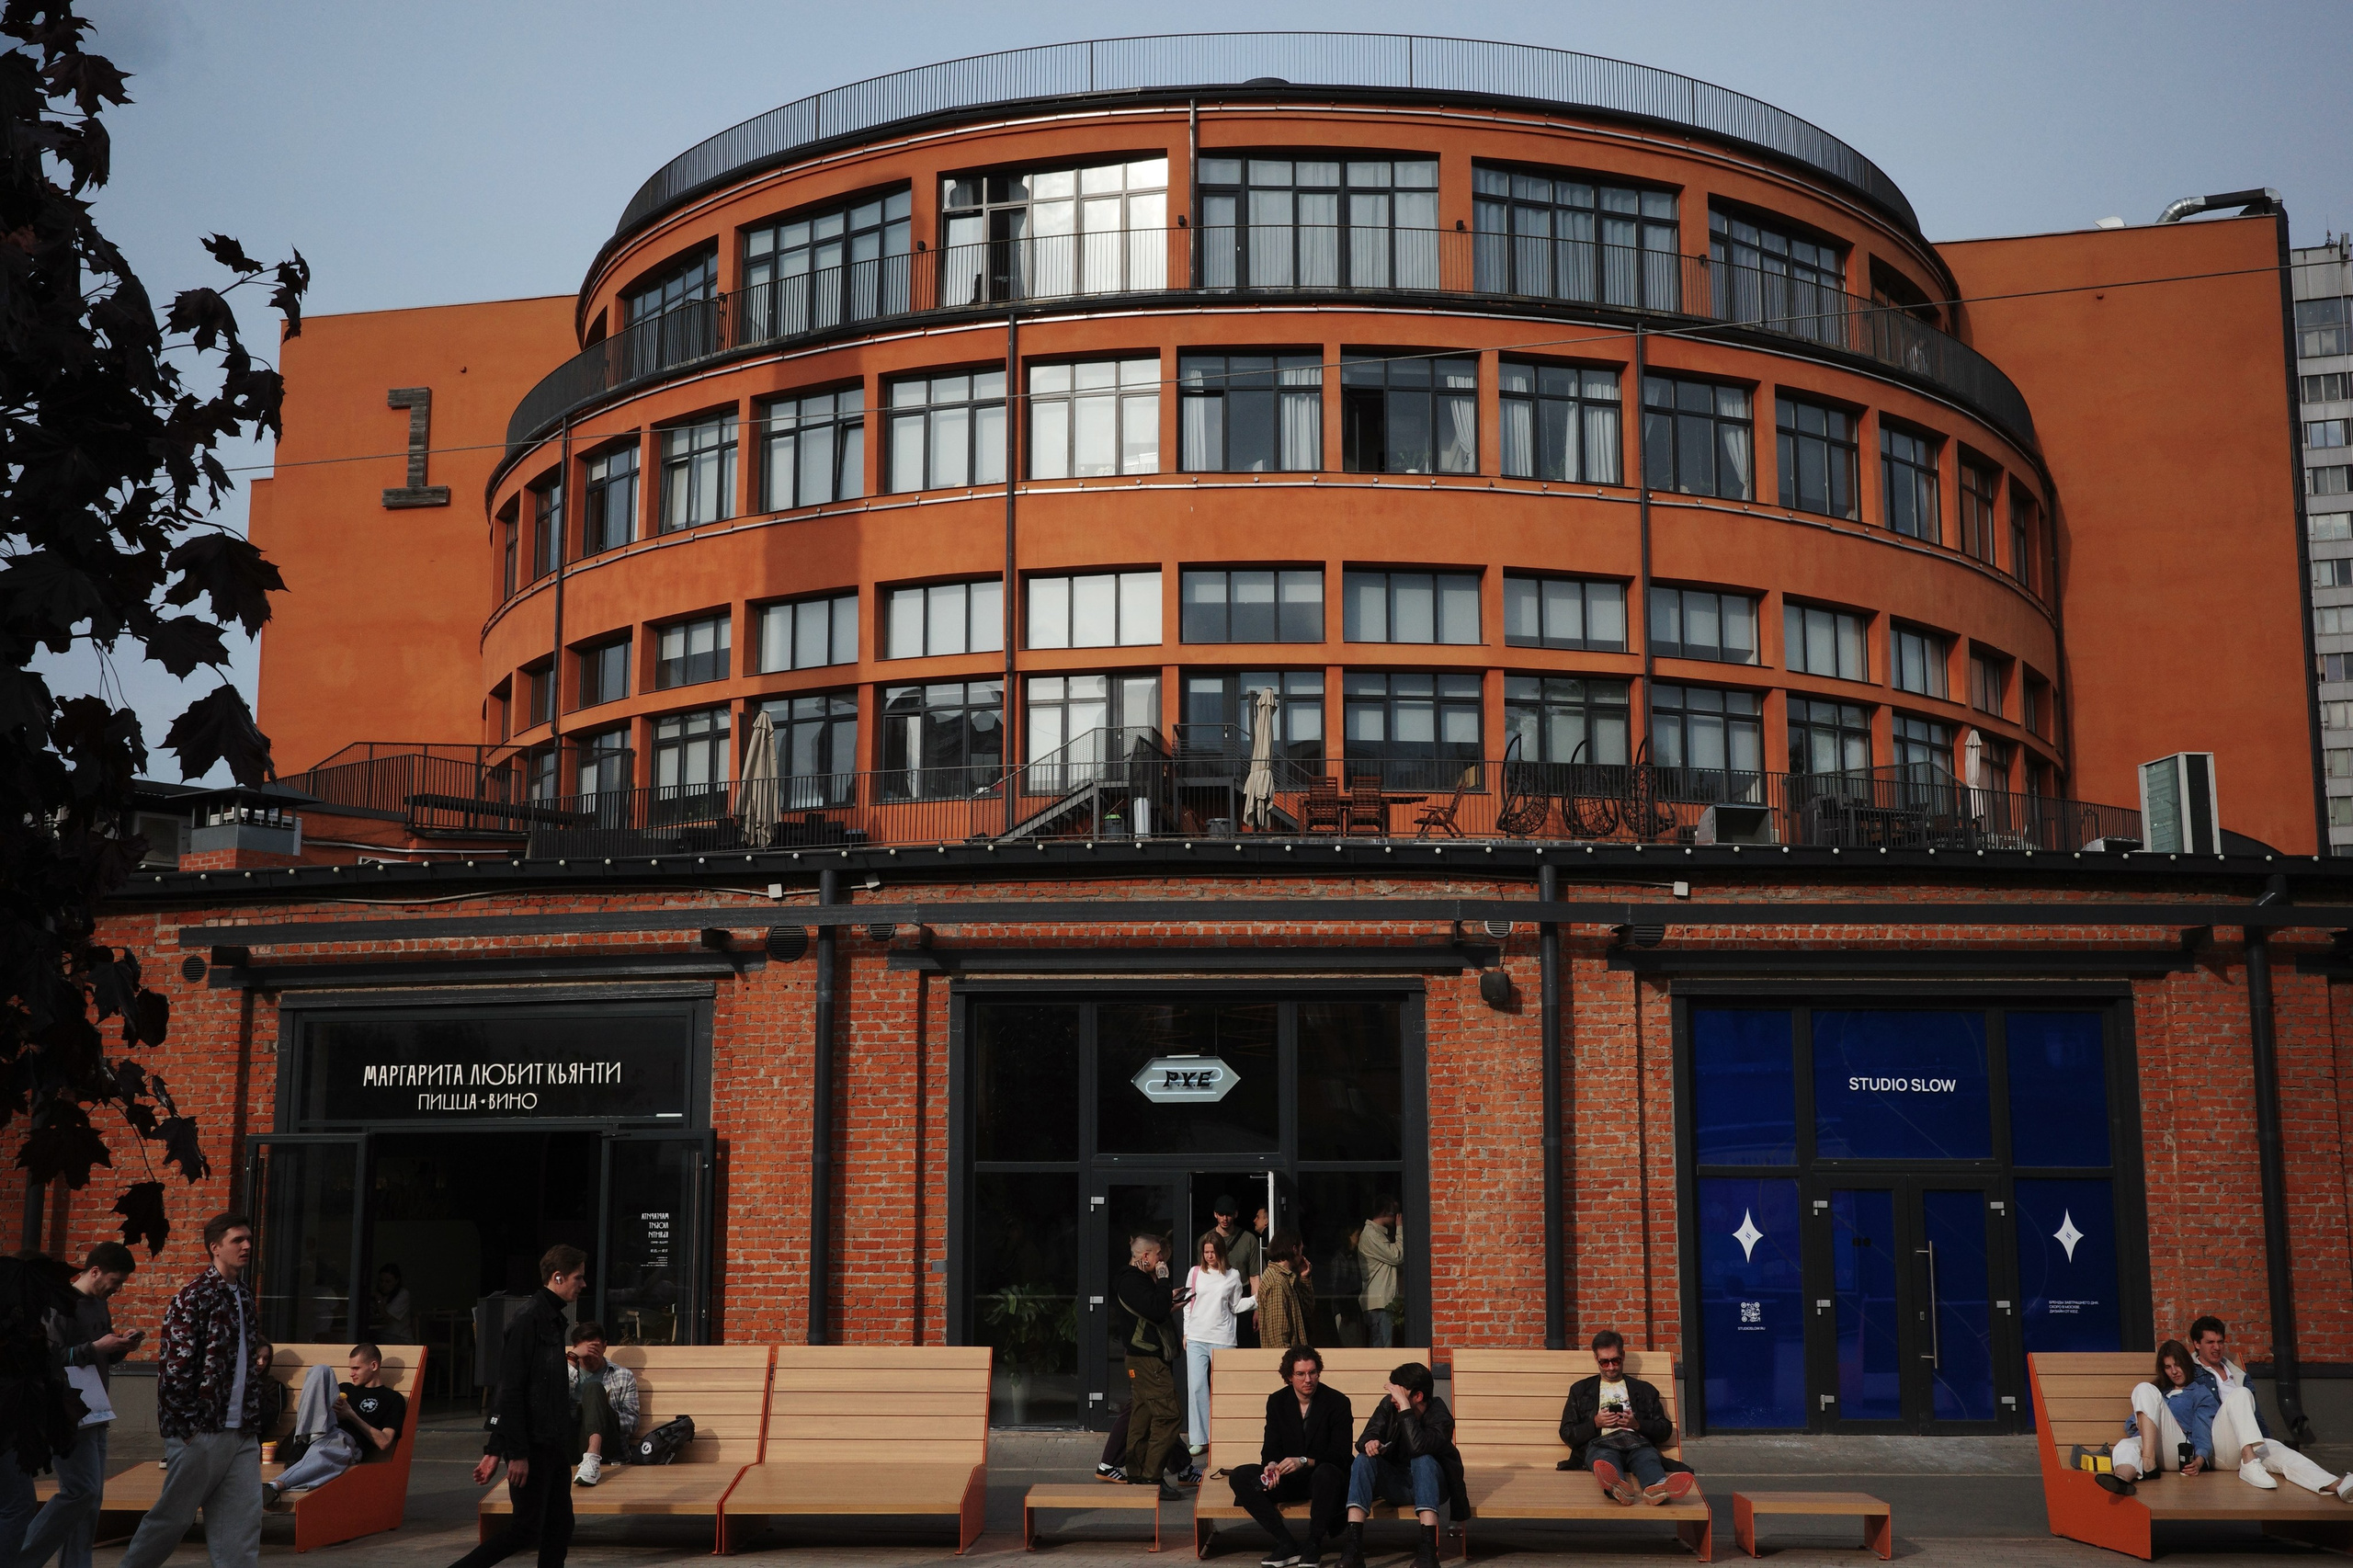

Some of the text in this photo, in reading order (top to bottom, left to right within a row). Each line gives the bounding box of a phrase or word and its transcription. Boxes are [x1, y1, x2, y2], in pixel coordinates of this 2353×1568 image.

[382, 386, 450, 508] 1
[363, 1062, 622, 1086] МАРГАРИТА ЛЮБИТ КЬЯНТИ
[1848, 1077, 1956, 1092] STUDIO SLOW
